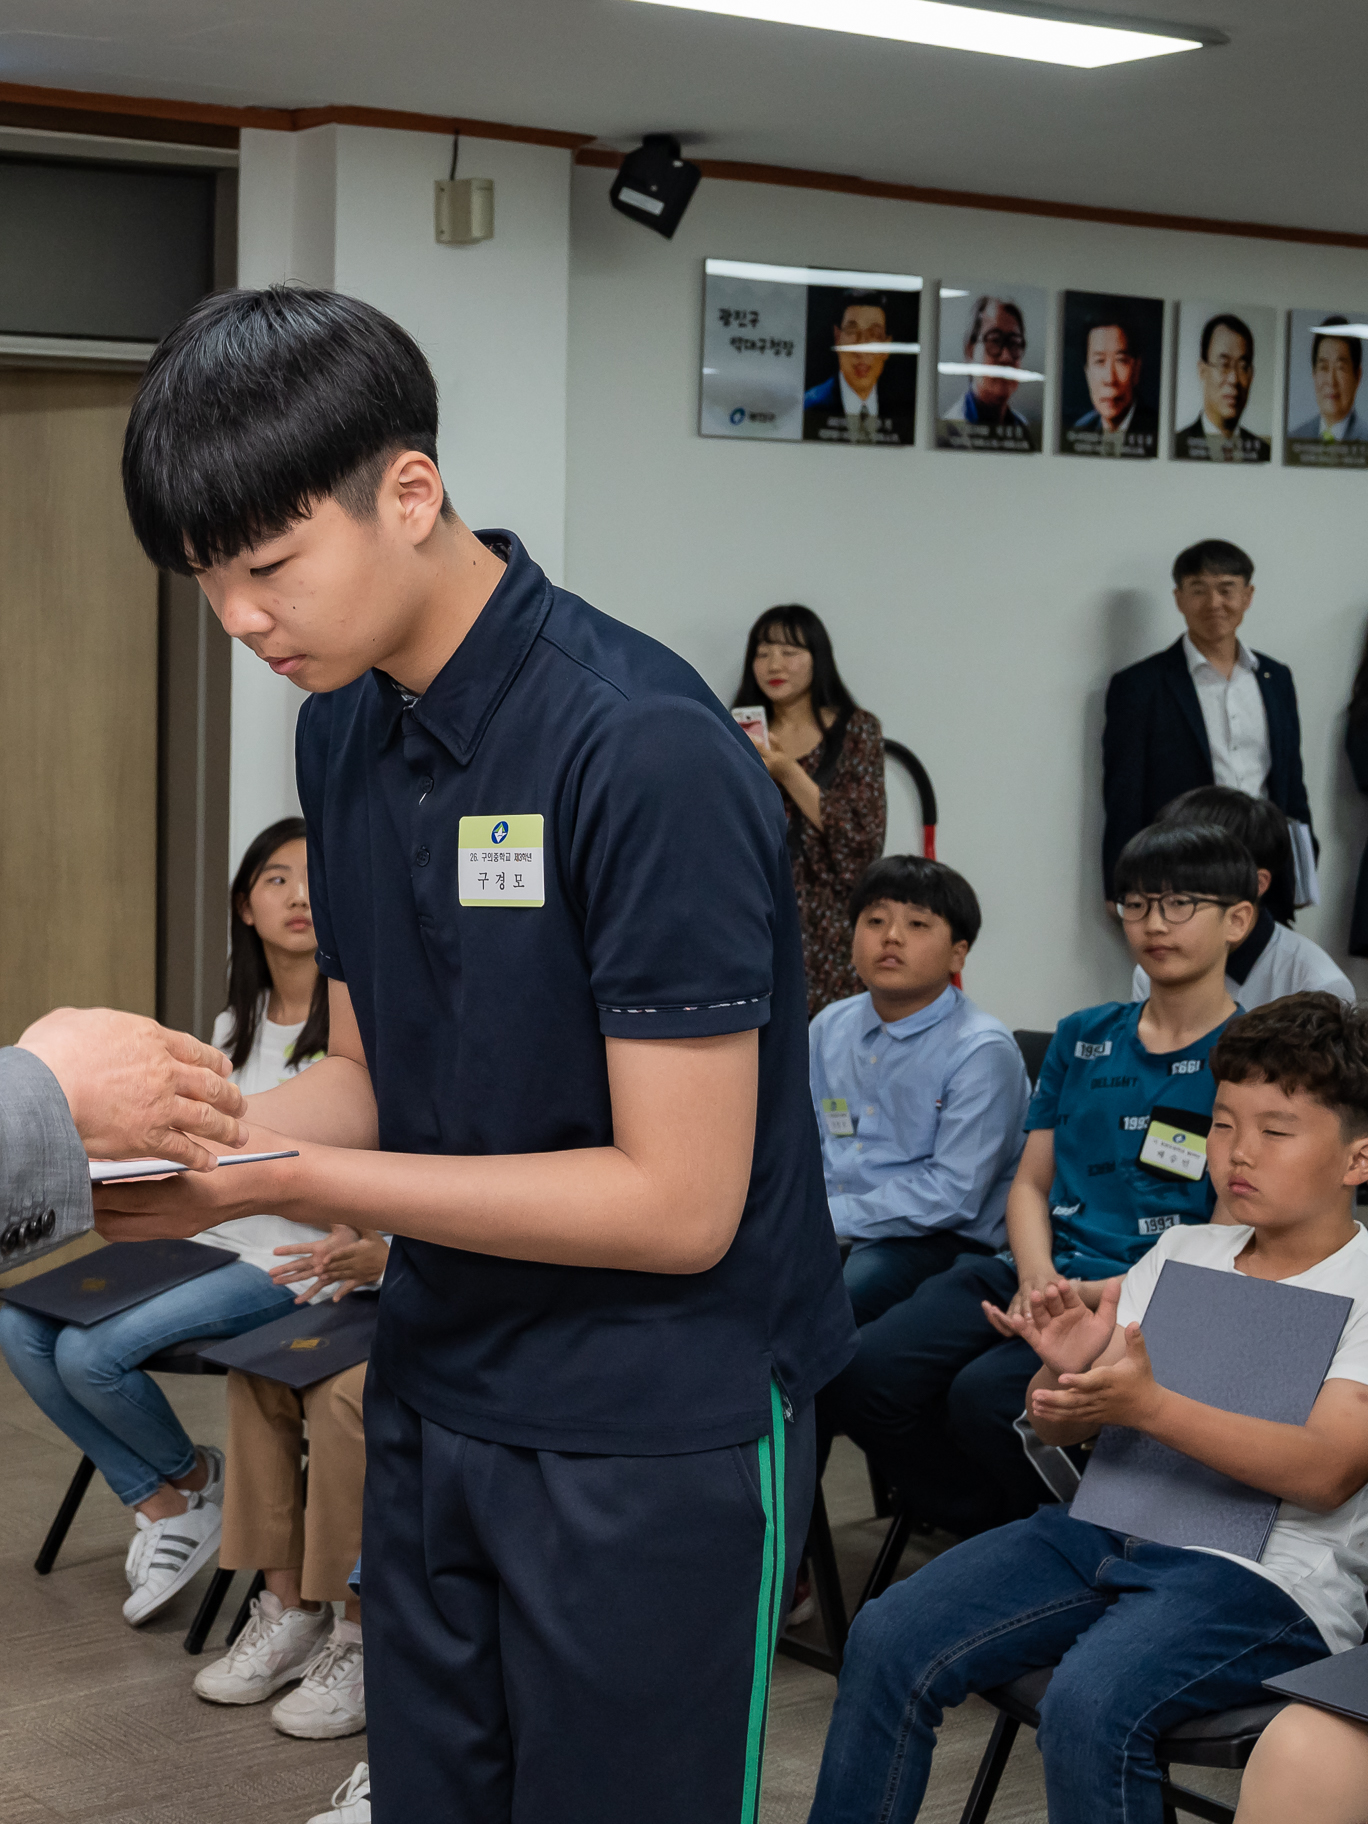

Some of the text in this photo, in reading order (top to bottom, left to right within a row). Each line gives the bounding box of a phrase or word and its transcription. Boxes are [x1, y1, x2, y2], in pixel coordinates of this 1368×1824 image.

[718, 308, 759, 328] 광진구
[481, 852, 512, 862] 구의중학교
[1091, 1075, 1138, 1089] DELIGHT
